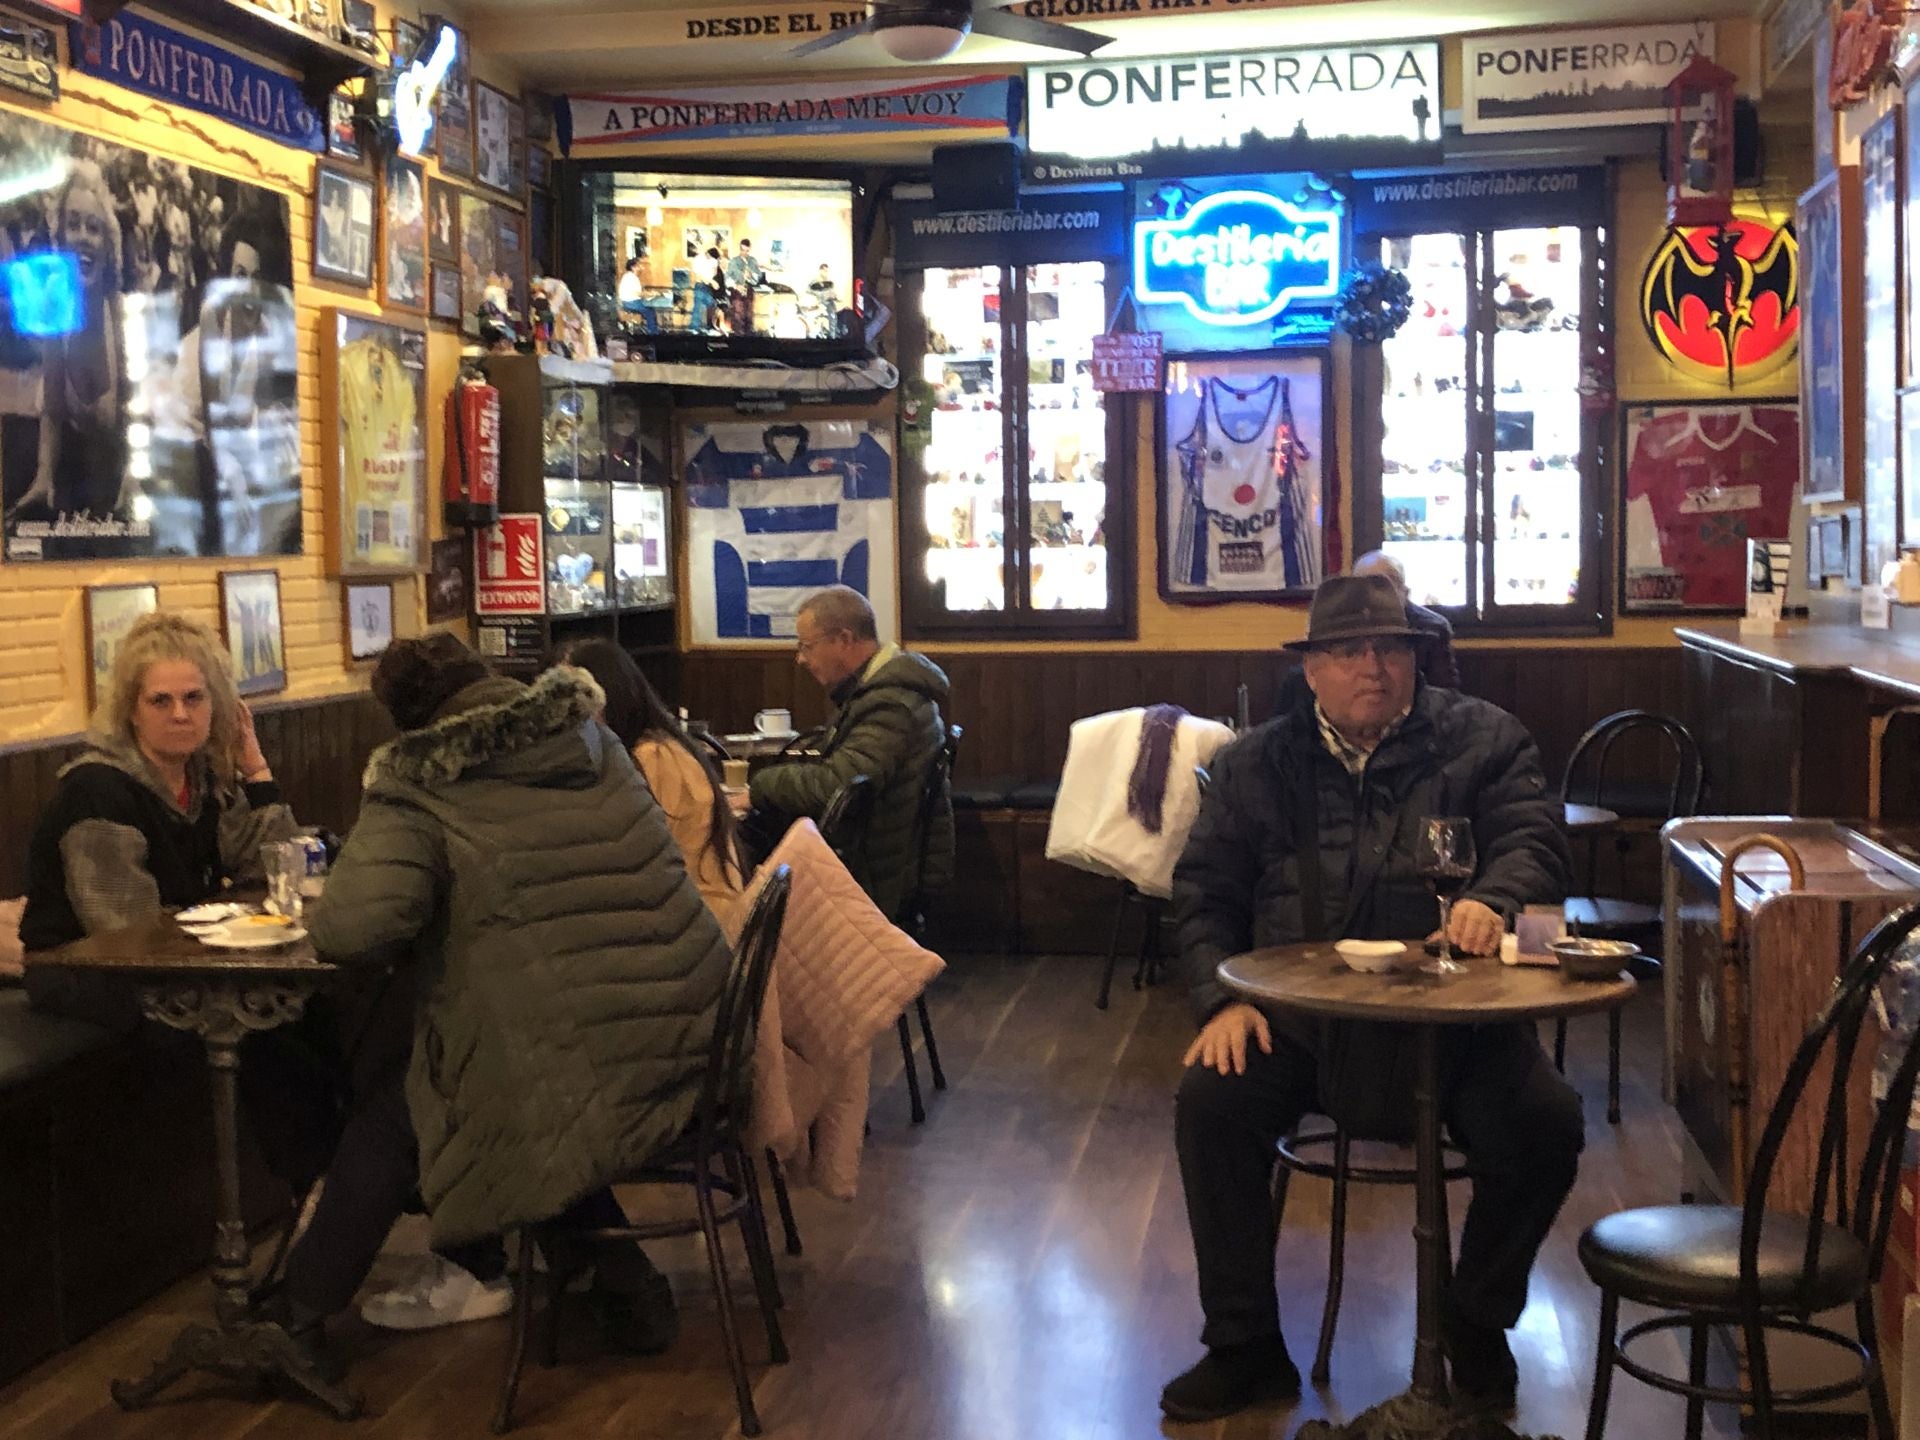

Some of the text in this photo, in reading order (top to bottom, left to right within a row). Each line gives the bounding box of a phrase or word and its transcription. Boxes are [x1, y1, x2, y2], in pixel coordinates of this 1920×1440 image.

[687, 15, 780, 39] DESDE
[788, 13, 822, 33] EL
[1477, 39, 1698, 76] PONFERRADA
[110, 20, 290, 133] PONFERRADA
[1045, 50, 1428, 108] PONFERRADA
[603, 92, 966, 130] A PONFERRADA ME VOY
[1374, 173, 1578, 203] www.destileriabar.com
[912, 210, 1099, 234] www.destileriabar.com
[482, 591, 540, 604] EXTINTOR
